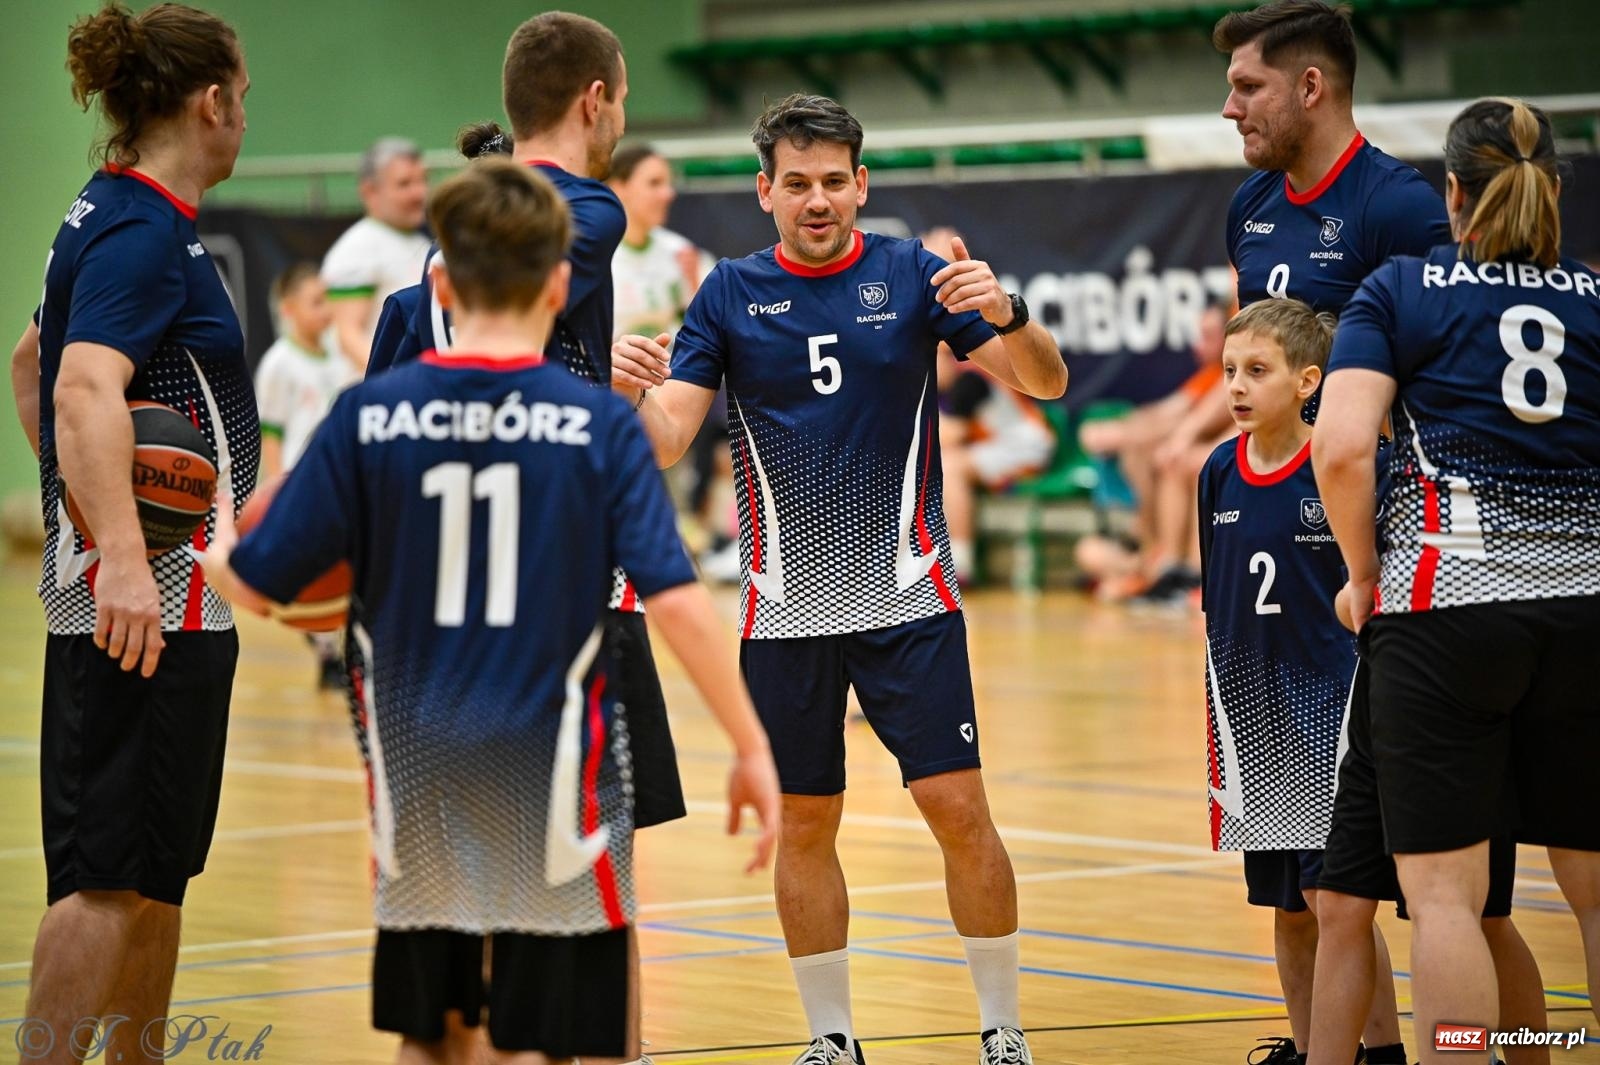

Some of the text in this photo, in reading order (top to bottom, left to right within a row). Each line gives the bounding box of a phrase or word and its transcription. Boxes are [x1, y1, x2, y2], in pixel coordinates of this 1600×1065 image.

[1309, 250, 1344, 260] RACIBÓRZ
[1423, 260, 1600, 299] RACIBÓR
[856, 312, 898, 324] RACIBÓRZ
[808, 334, 842, 395] 5
[1499, 304, 1567, 424] 8
[357, 389, 592, 446] RACIBÓRZ
[421, 461, 521, 628] 11
[1249, 551, 1281, 615] 2
